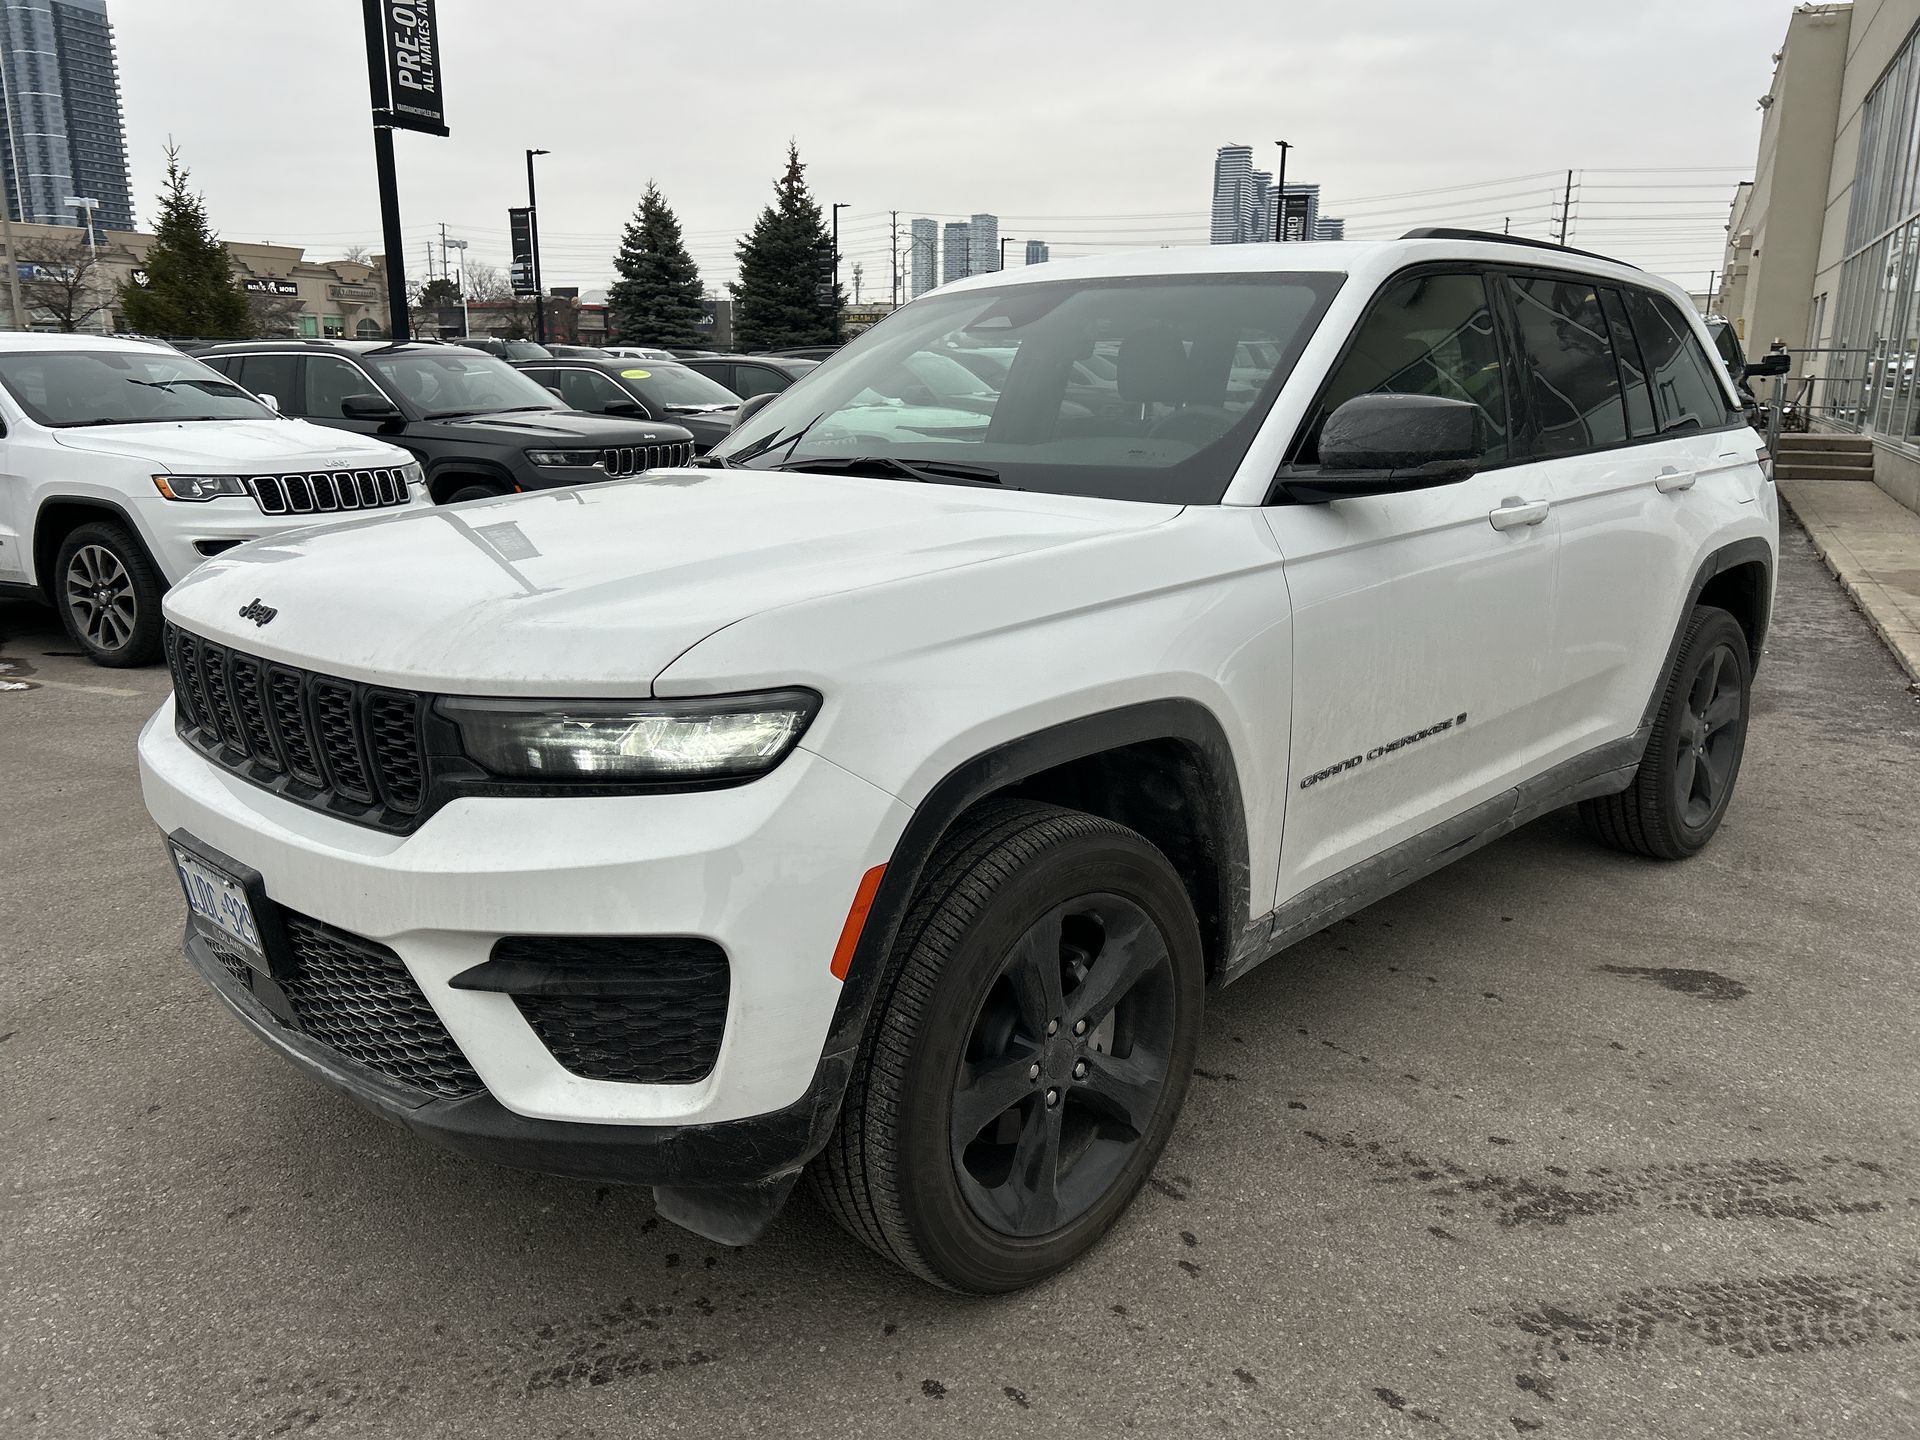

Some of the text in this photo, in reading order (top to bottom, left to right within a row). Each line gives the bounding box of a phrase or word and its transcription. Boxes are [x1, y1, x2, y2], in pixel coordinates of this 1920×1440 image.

[392, 0, 422, 90] PRE-O
[418, 18, 432, 66] MAKES
[422, 70, 435, 93] ALL
[324, 457, 351, 468] Jeep
[239, 598, 278, 627] Jeep
[1300, 717, 1454, 789] GRAND CHEROKEE
